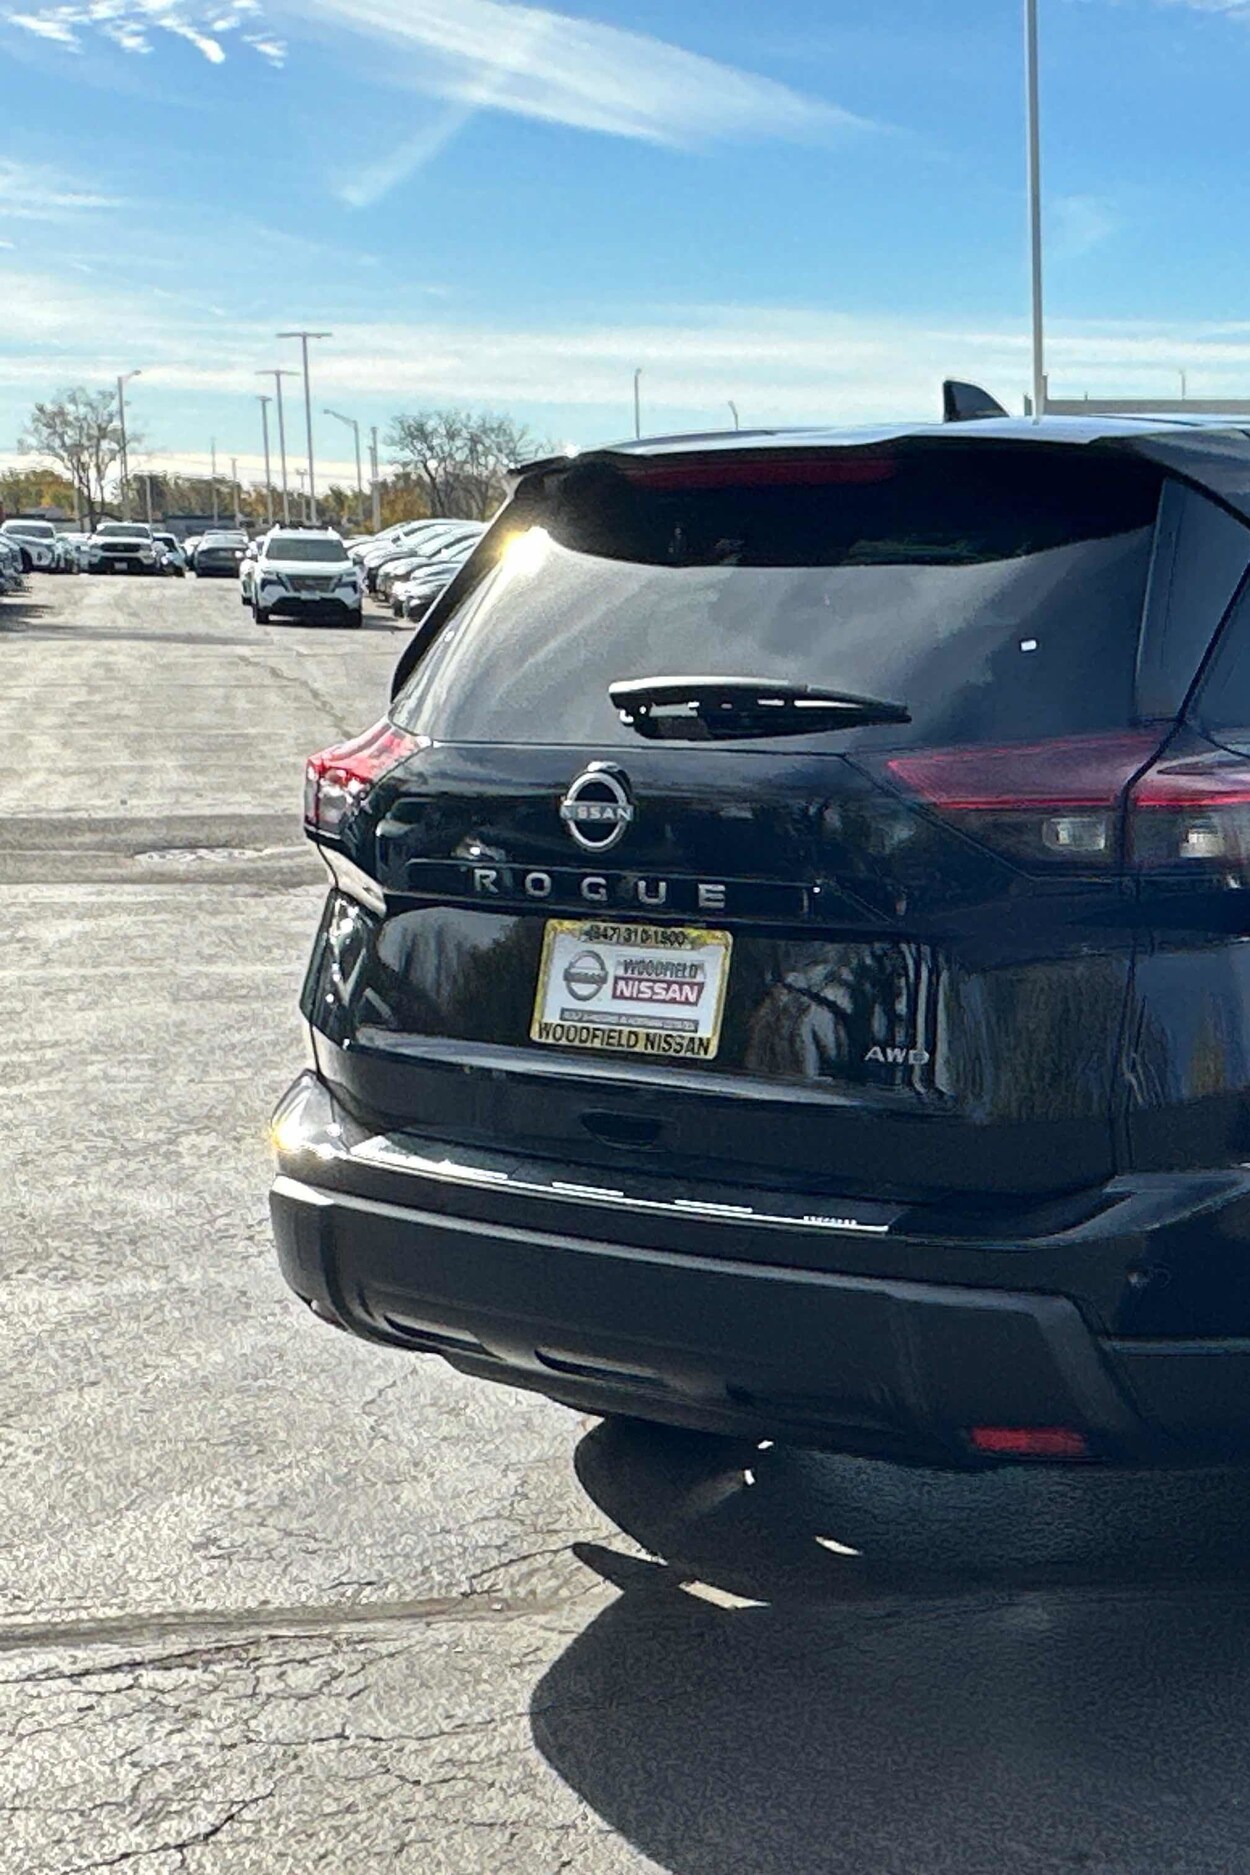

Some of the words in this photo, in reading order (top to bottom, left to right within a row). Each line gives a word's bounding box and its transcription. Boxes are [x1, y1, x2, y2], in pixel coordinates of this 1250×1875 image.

[473, 868, 726, 909] ROGUE
[624, 959, 698, 979] WOODFIELD
[616, 979, 698, 1003] NISSAN
[538, 1022, 639, 1049] WOODFIELD
[643, 1031, 711, 1056] NISSAN
[864, 1046, 930, 1065] AWD
